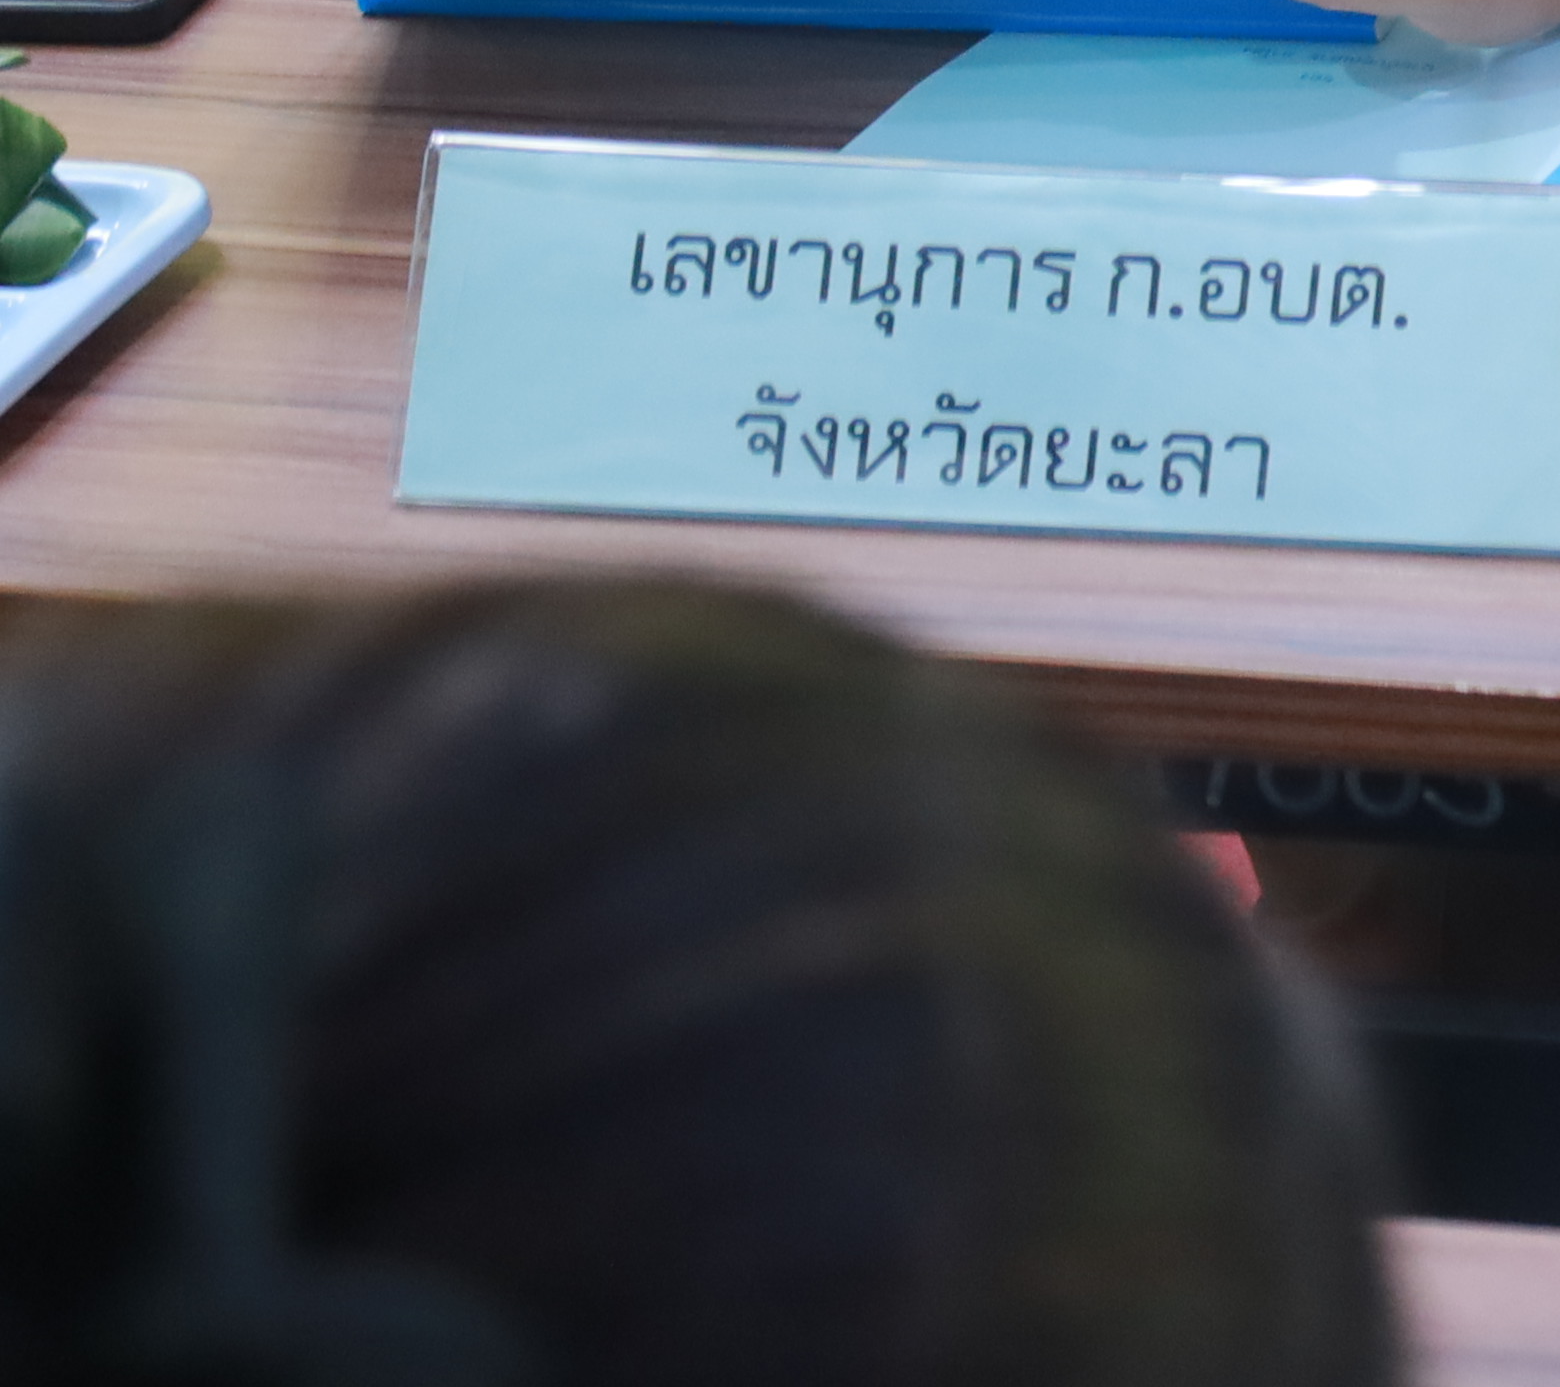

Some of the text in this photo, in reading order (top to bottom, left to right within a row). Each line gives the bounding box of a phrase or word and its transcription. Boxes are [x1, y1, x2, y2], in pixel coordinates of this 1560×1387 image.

[629, 231, 1409, 337] เลขานุการ ก.อบต.
[735, 383, 1272, 501] จังหวัดยะลา
